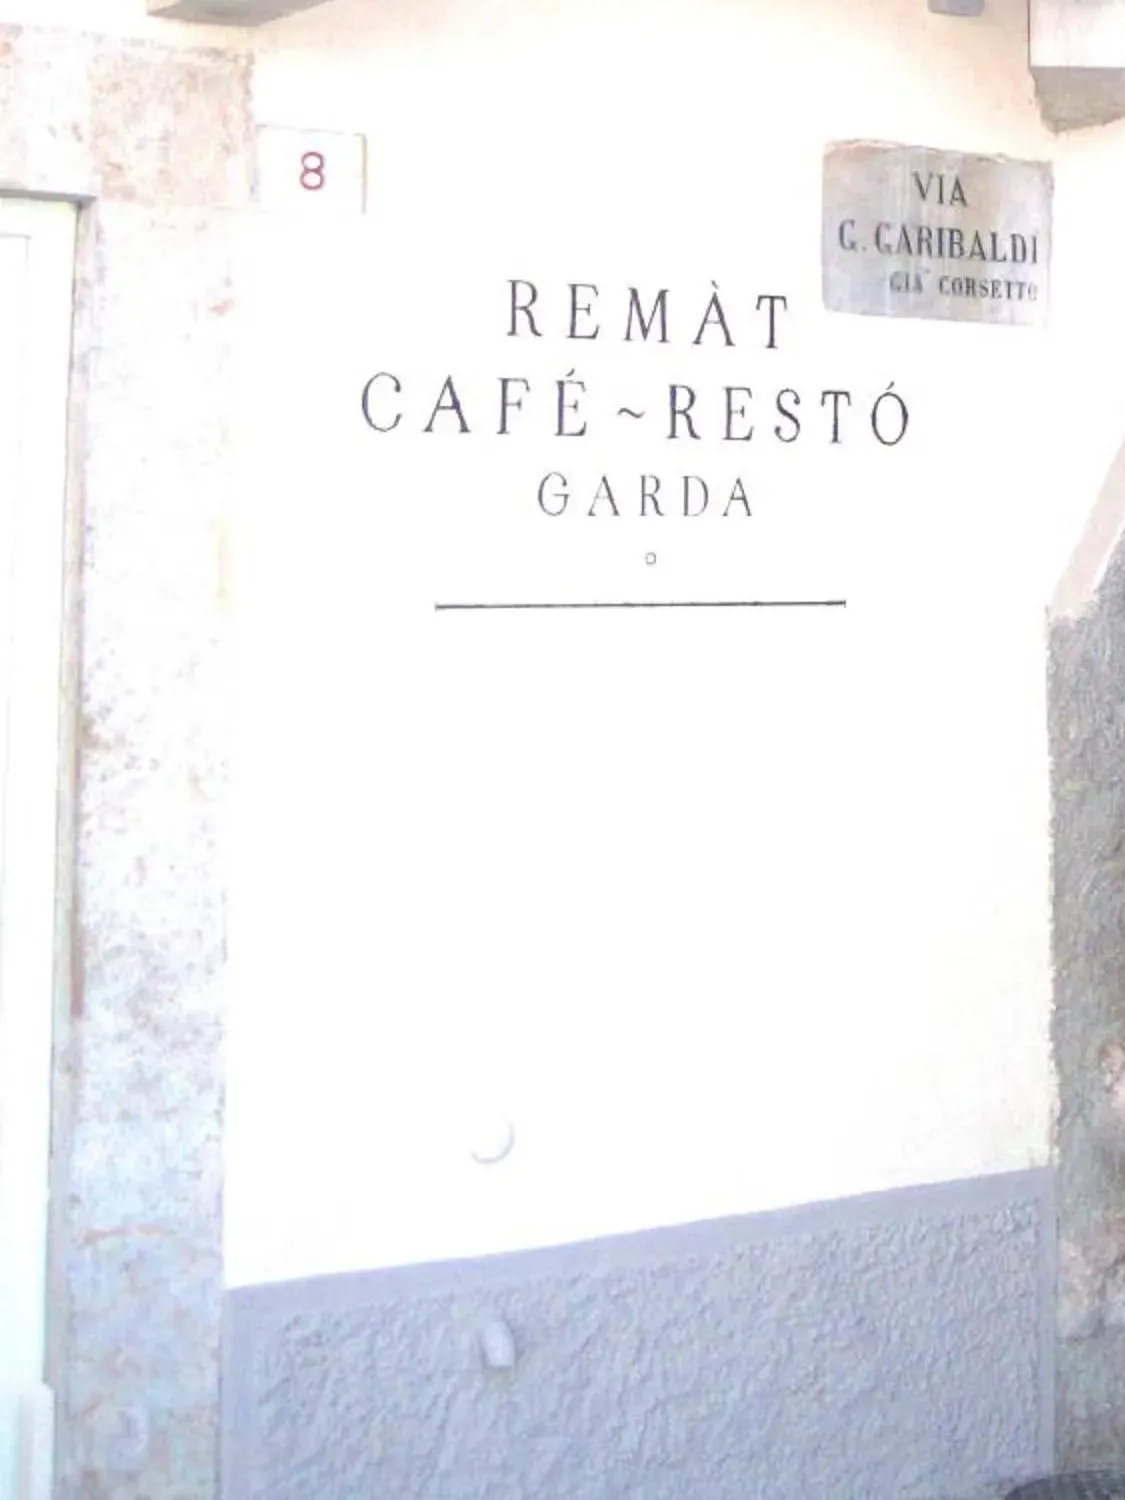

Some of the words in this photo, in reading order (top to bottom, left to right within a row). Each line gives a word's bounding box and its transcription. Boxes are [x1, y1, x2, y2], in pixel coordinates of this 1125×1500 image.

[299, 151, 325, 191] 8
[912, 171, 967, 207] VIA
[838, 219, 867, 253] G.
[875, 222, 1038, 264] GARIBALDI
[507, 280, 787, 348] REMÀT
[538, 473, 752, 517] GARDA
